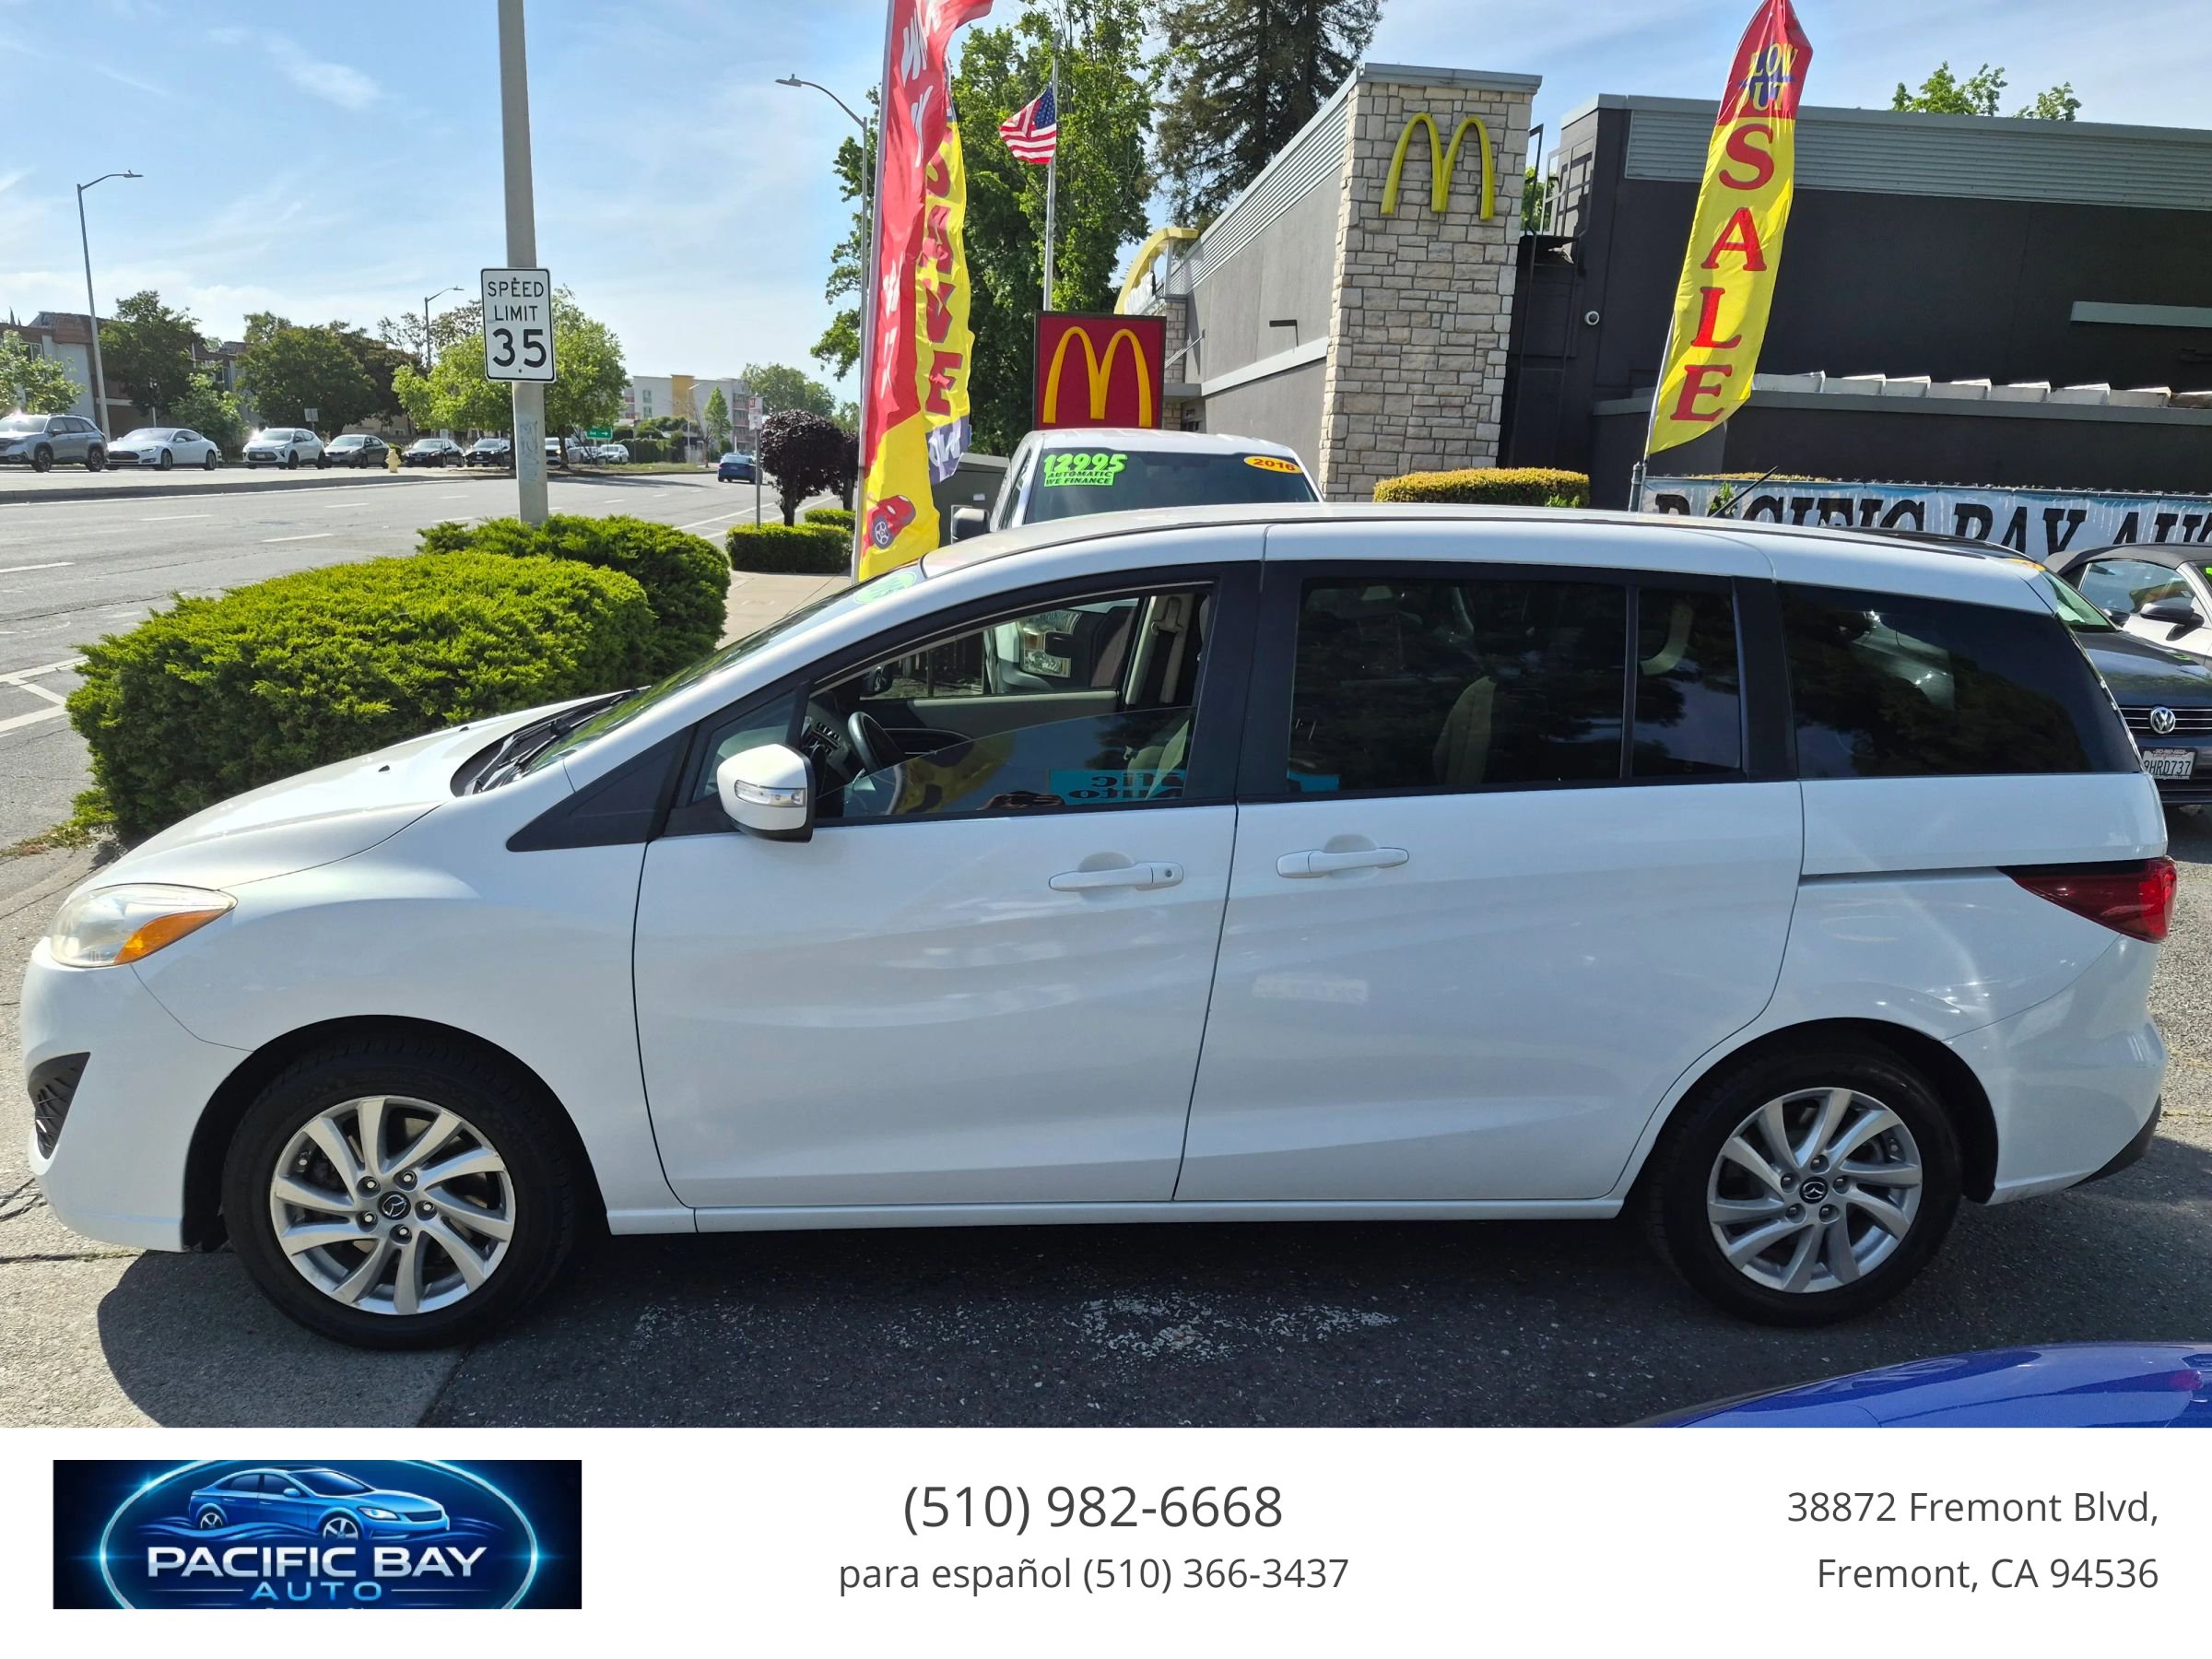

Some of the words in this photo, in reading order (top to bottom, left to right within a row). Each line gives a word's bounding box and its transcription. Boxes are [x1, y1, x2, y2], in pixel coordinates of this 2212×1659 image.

[1669, 123, 1775, 422] SALE
[488, 281, 544, 297] SPEED
[494, 305, 538, 322] LIMIT
[492, 328, 547, 368] 35
[1043, 453, 1128, 474] 12995
[1253, 458, 1297, 471] 2016
